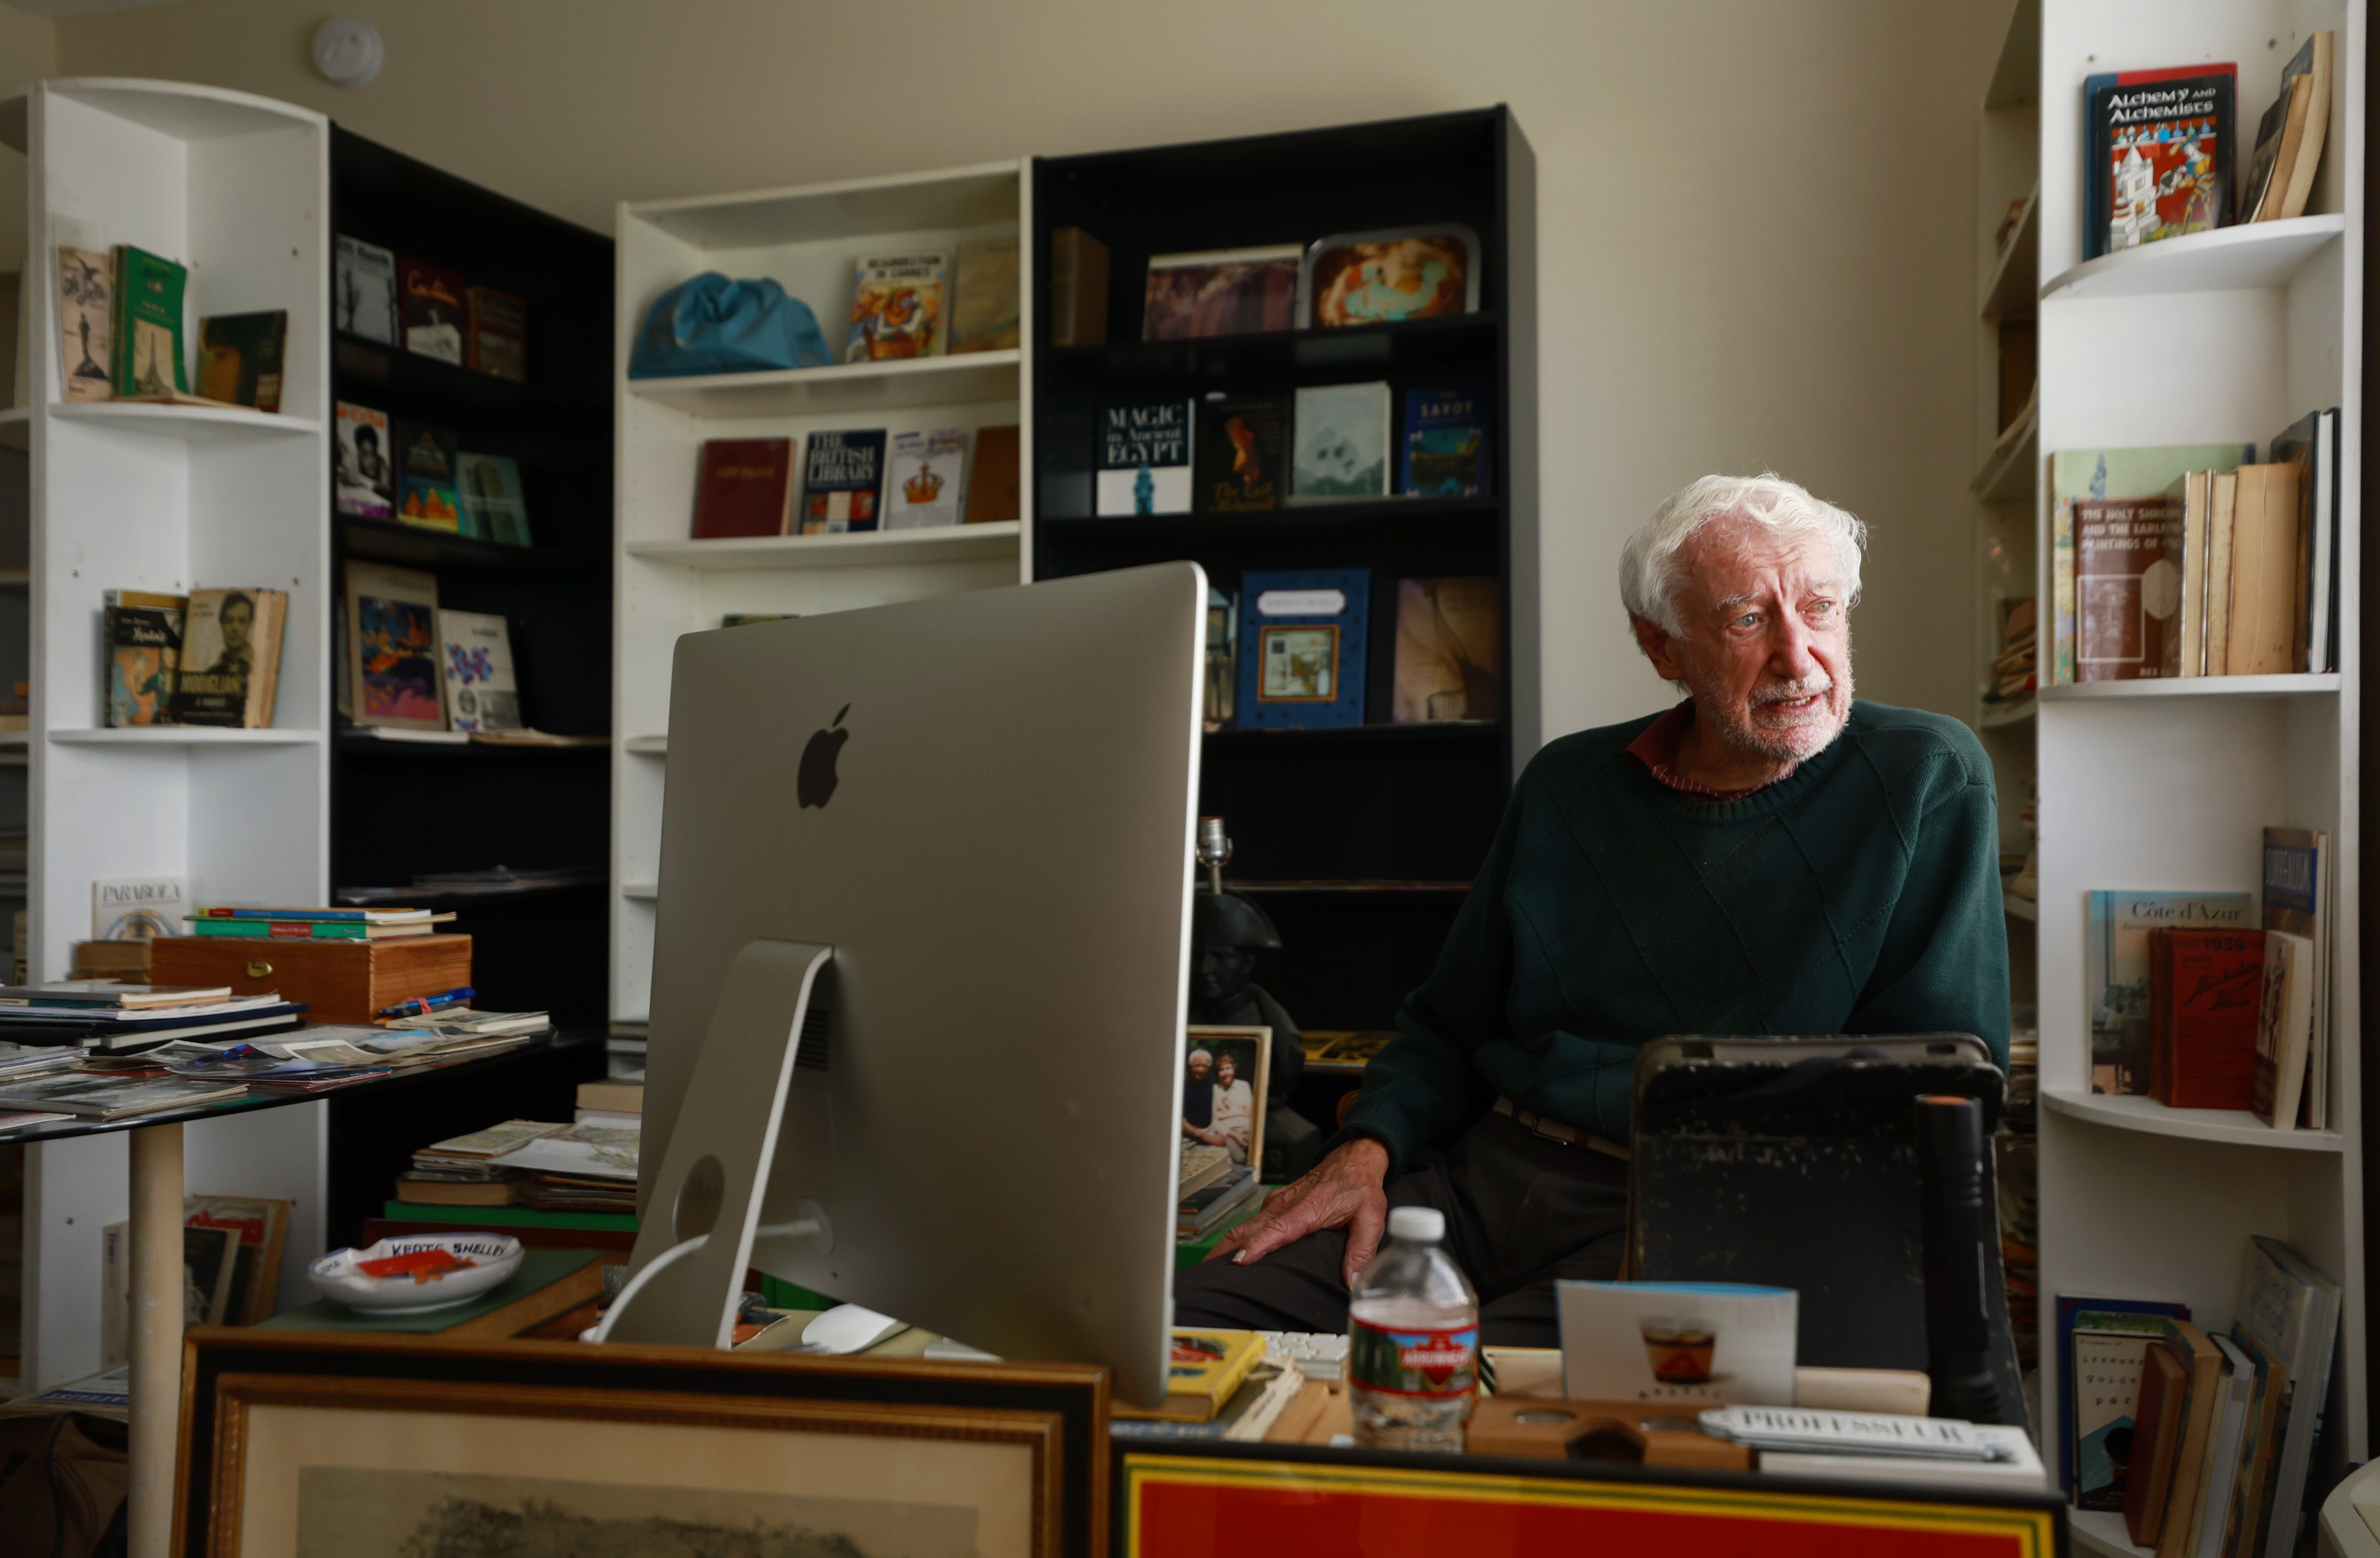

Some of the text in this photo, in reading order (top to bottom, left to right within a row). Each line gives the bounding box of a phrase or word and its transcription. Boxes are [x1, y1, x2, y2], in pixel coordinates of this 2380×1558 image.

[1108, 404, 1184, 428] MAGIC
[1420, 400, 1474, 417] SAVOY
[809, 434, 846, 448] THE
[1106, 426, 1183, 444] in Ancient
[809, 446, 876, 465] BRITISH
[1107, 441, 1184, 464] EGYPT
[807, 463, 876, 481] LIBRARY
[2083, 509, 2102, 520] THE
[2106, 508, 2134, 519] HOLY
[2083, 524, 2106, 535] AND
[2109, 523, 2130, 535] THE
[2083, 538, 2140, 550] PAINTINGS
[2144, 537, 2158, 549] OF
[2140, 667, 2158, 677] REX
[103, 883, 181, 902] PARABOLA
[2132, 901, 2243, 919] Côte d'Azur
[2204, 937, 2245, 952] 1939
[454, 1243, 505, 1256] SHELLEY
[1743, 1411, 1965, 1443] PROFESSEUR
